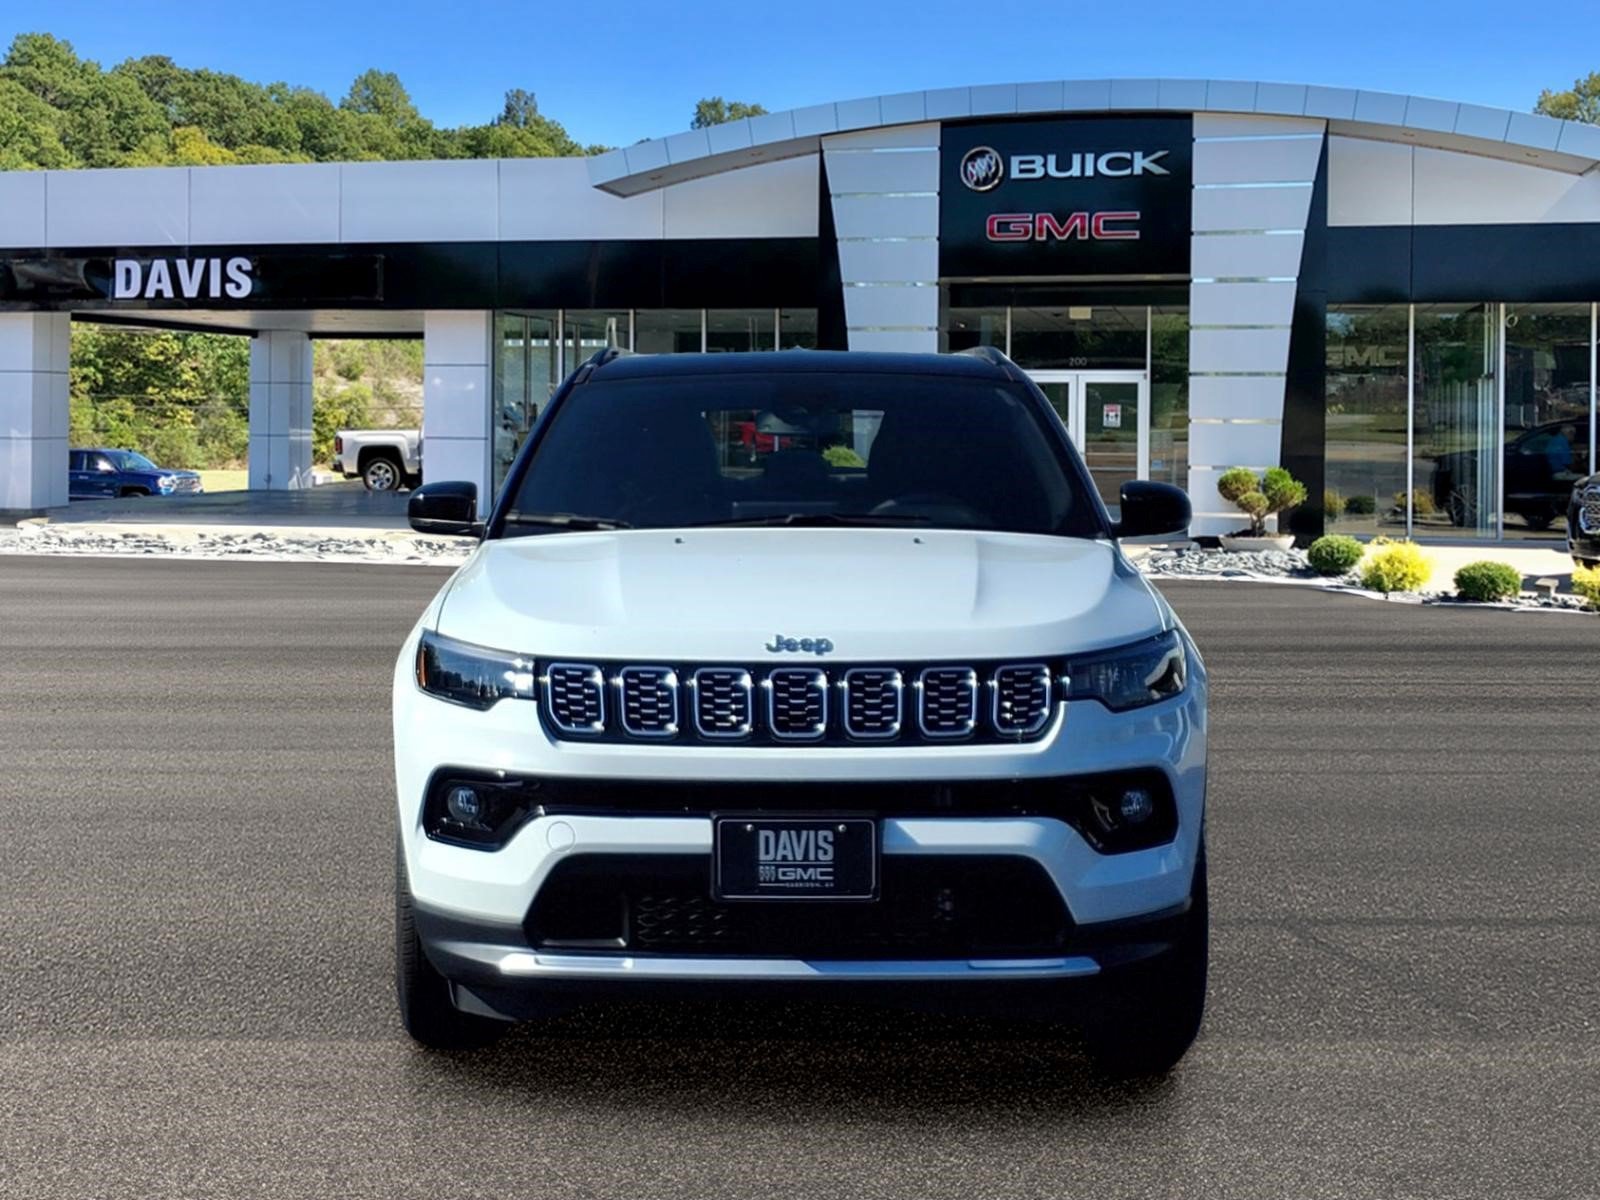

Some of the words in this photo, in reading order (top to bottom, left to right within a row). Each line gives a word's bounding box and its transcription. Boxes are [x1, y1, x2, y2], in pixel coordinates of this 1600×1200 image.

[1010, 150, 1170, 179] BUICK
[986, 211, 1140, 241] GMC
[114, 256, 253, 299] DAVIS
[1068, 356, 1088, 367] 200
[765, 634, 834, 656] Jeep
[758, 830, 834, 861] DAVIS
[778, 867, 834, 880] GMC
